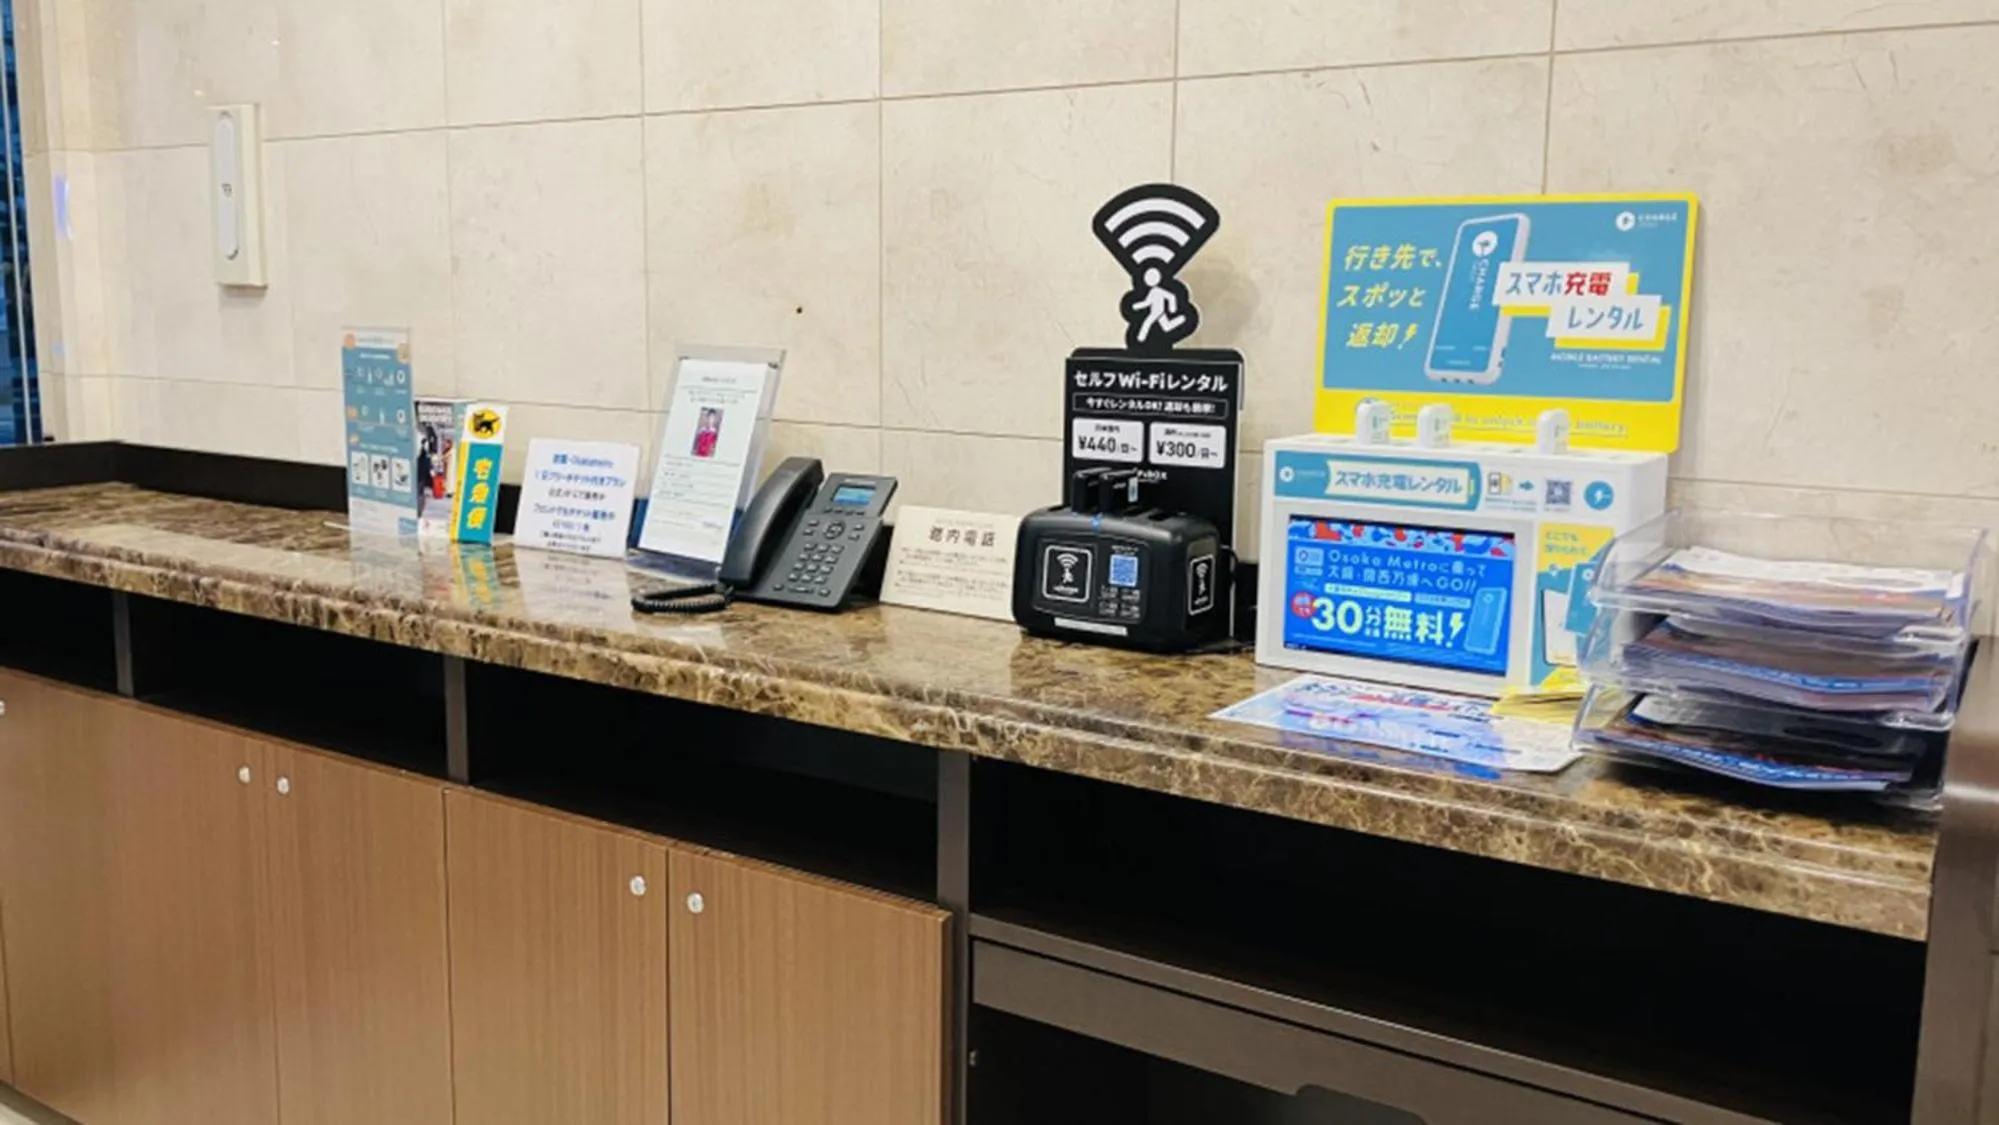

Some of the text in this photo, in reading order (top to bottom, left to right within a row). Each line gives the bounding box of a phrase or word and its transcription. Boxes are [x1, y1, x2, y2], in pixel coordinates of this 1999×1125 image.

[1343, 244, 1442, 272] 行き先で、
[1337, 283, 1428, 309] スポッと
[1504, 270, 1614, 297] スマホ充電
[1567, 304, 1645, 331] レンタル
[1074, 370, 1229, 392] セルフWi-Fiレンタル
[1335, 470, 1463, 494] スマホ充電レンタル
[1328, 549, 1382, 566] Osaka
